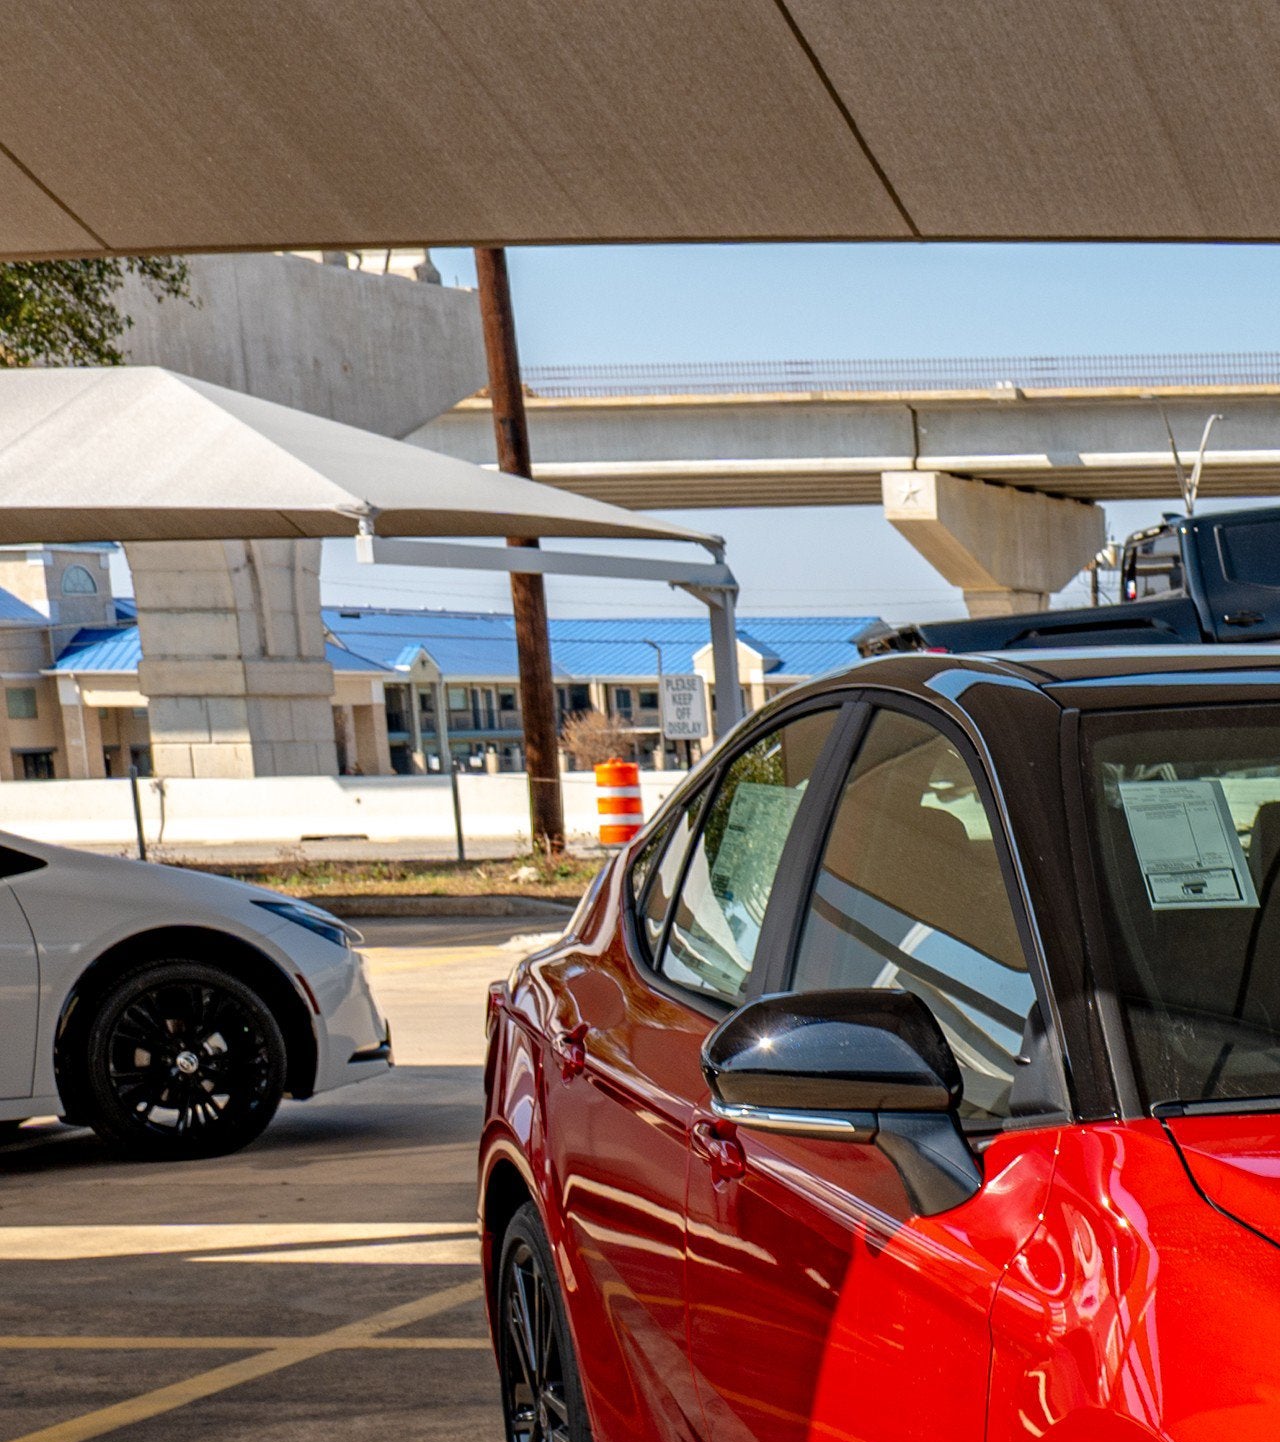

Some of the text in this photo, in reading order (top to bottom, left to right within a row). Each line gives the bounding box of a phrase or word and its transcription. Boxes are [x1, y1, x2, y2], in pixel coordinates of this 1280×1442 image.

[665, 678, 697, 691] PLEASE
[672, 692, 693, 705] KEEP
[676, 706, 690, 720] OFF
[668, 721, 702, 735] DISPLAY
